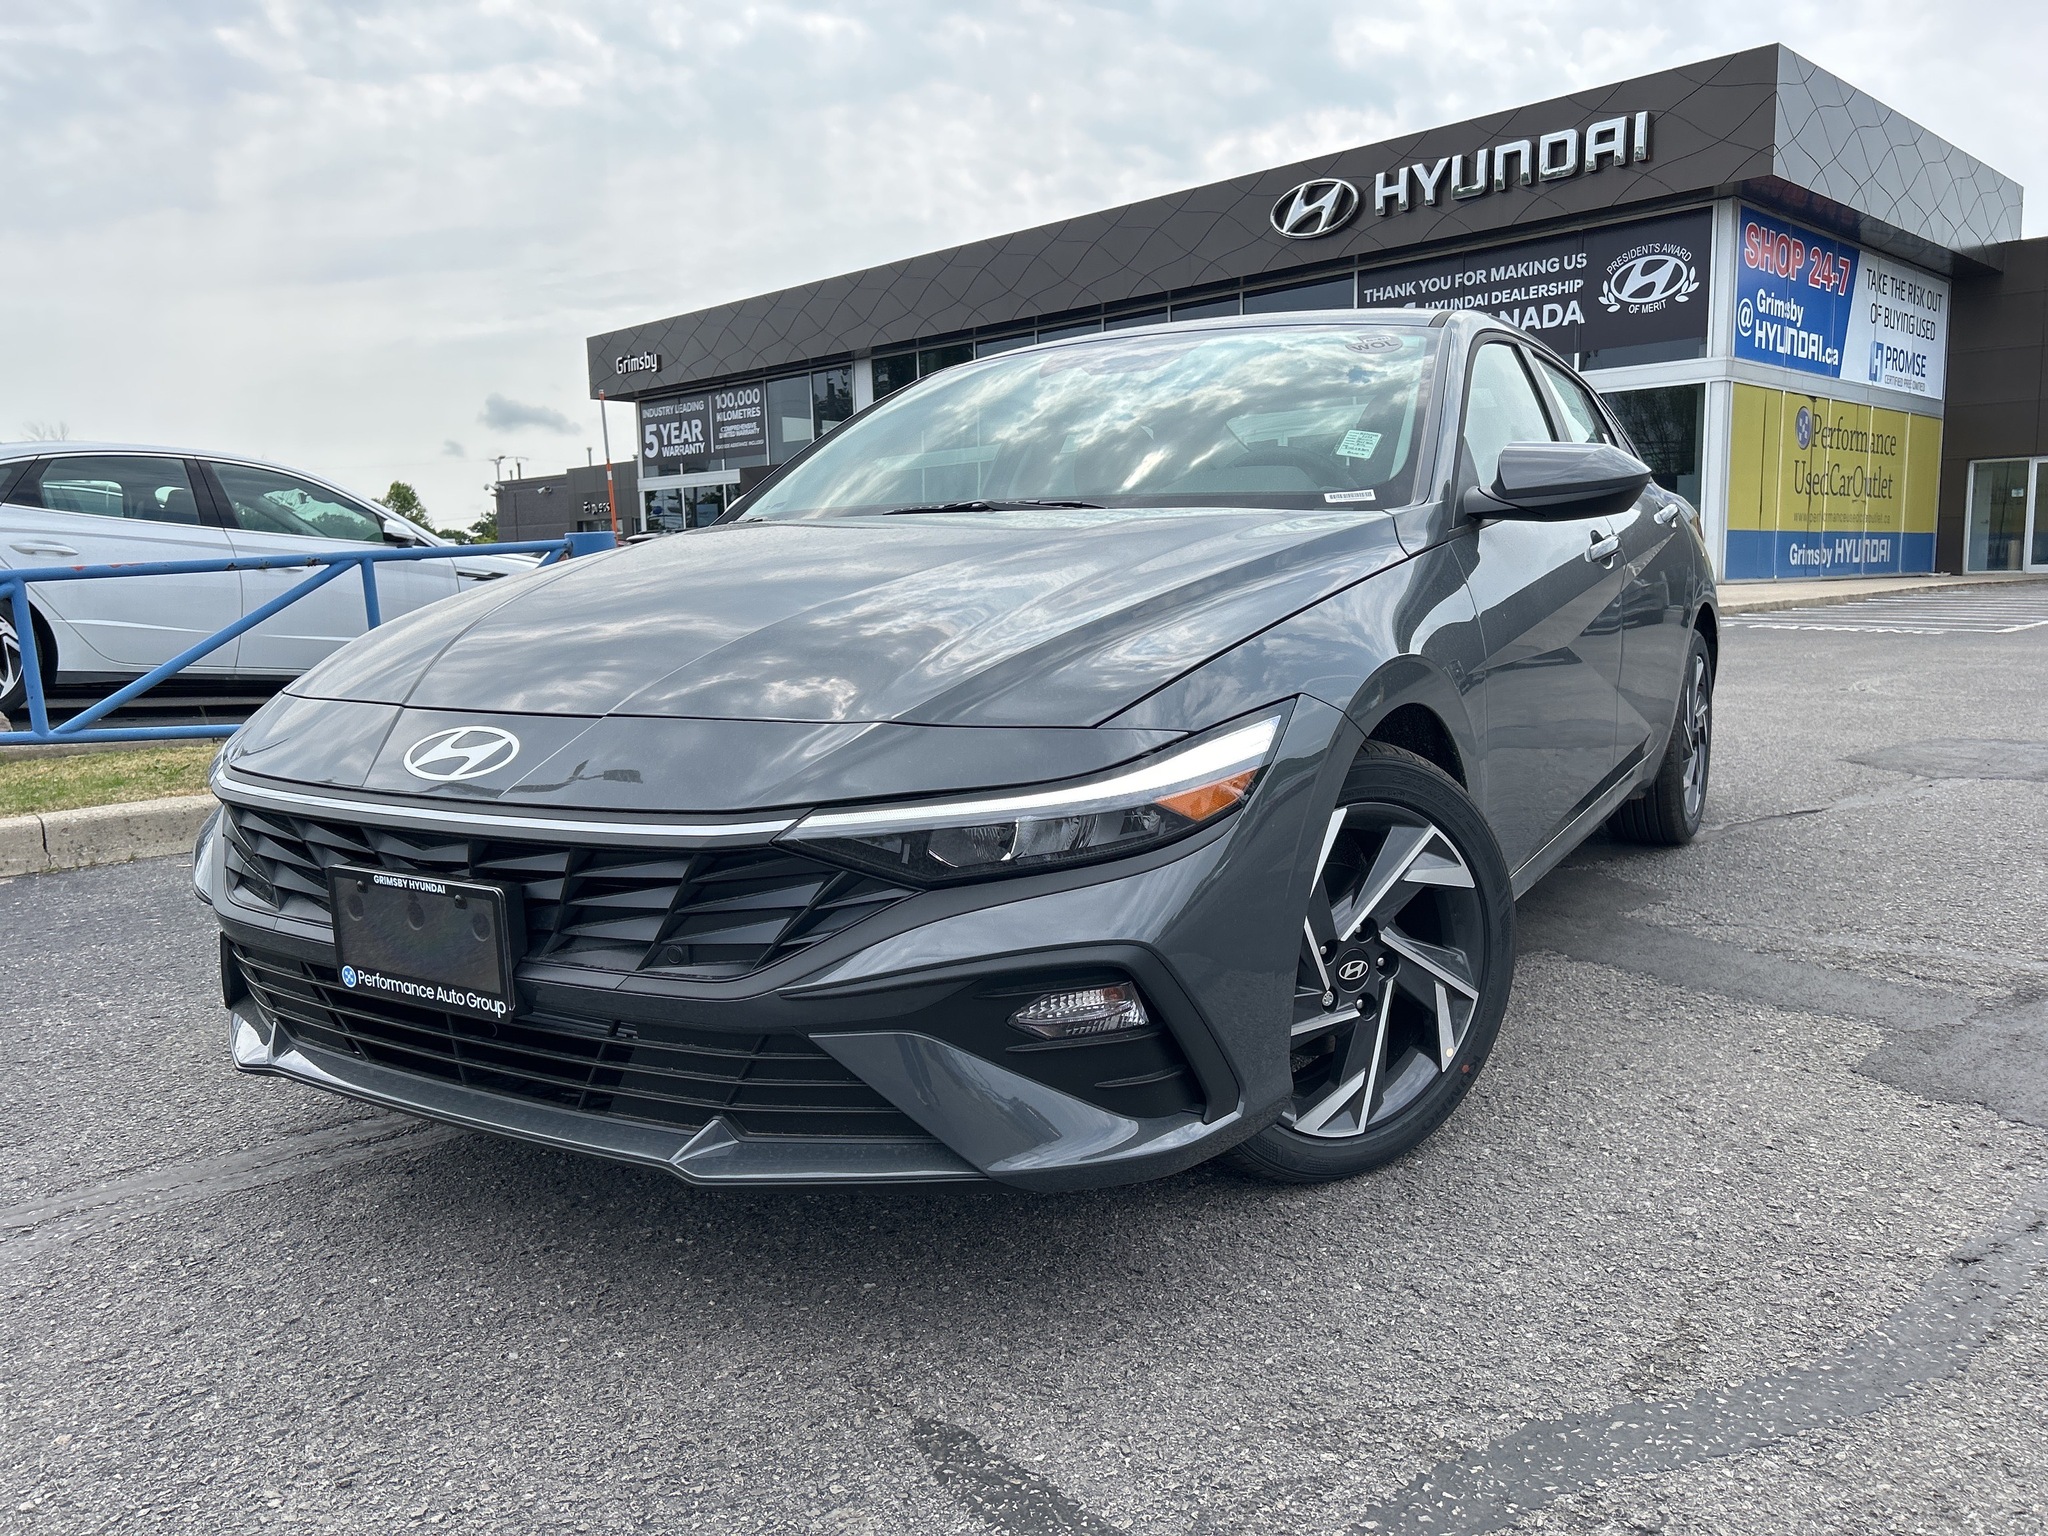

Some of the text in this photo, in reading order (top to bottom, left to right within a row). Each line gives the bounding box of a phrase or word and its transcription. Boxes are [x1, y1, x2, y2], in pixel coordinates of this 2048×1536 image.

[1374, 110, 1650, 217] HYUNDAI
[1606, 243, 1692, 275] PRESIDENT'S AWARD
[1744, 222, 1805, 281] SHOP
[1363, 253, 1587, 303] THANK YOU FOR MAKING US
[1425, 279, 1584, 310] HYUNDAI DEALERSHIP
[1866, 268, 1942, 313] TAKE THE RISK OUT
[1490, 300, 1585, 331] NADA
[1628, 299, 1666, 314] OF MERIT
[1738, 298, 1753, 337] @
[1756, 288, 1804, 327] Grimsby
[1871, 303, 1936, 341] OF BUYING USED
[1754, 319, 1839, 366] HYUNDAI.ca
[615, 350, 658, 375] Grimsby
[1885, 346, 1926, 377] PROMISE
[642, 400, 704, 419] INDUSTRY LEADING
[715, 388, 760, 409] 100,000
[717, 406, 761, 422] KILOMETRES
[644, 419, 704, 458] 5 YEAR
[662, 442, 706, 458] WARRANTY
[1812, 414, 1897, 456] Performance
[1794, 460, 1893, 501] UsedCarOutlet
[1790, 539, 1890, 568] Grimsby HYUNDAI
[373, 875, 446, 894] GRIMSBY HYUNDAI
[357, 970, 506, 1018] Performance Auto Group
